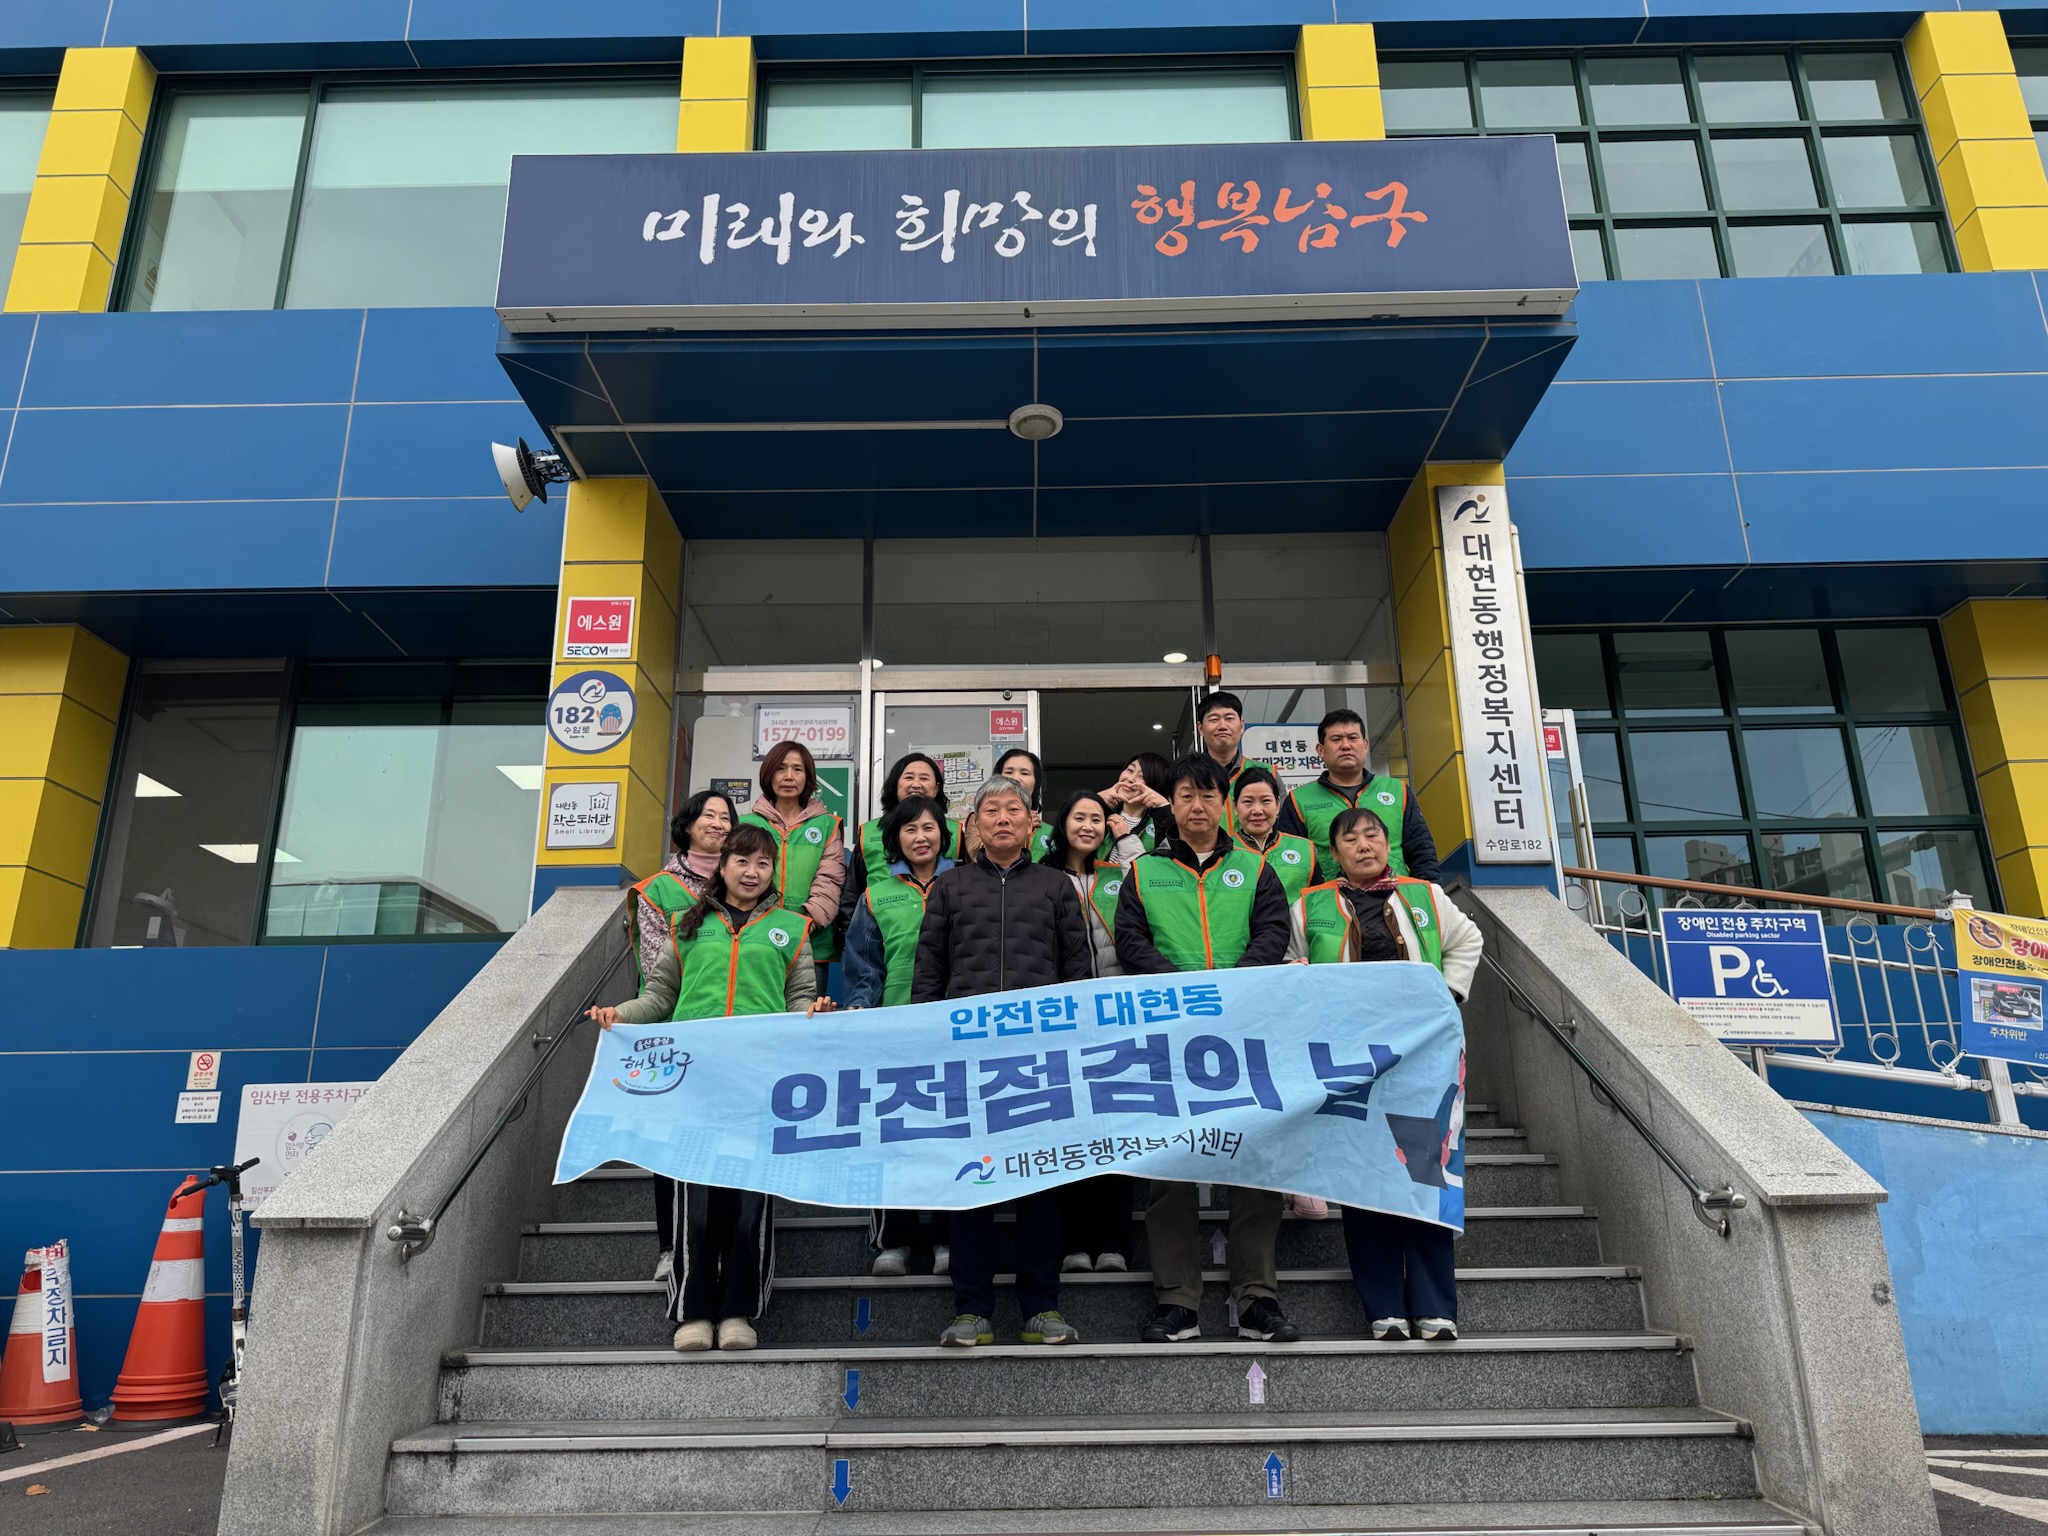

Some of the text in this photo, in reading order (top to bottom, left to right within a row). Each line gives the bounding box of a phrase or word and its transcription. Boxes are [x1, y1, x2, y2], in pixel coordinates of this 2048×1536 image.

[643, 180, 1428, 265] 미래와 희망의 행복남구
[577, 614, 622, 631] 에스원
[567, 646, 608, 655] SECOM
[1462, 534, 1526, 830] 대현동행정복지센터
[555, 706, 595, 724] 182
[995, 717, 1018, 726] 에스원
[564, 726, 590, 734] 수암로
[763, 727, 846, 742] 1577-0199
[1265, 740, 1307, 753] 대현동
[1298, 756, 1328, 770] 지원
[553, 813, 612, 827] 작은도서관
[1485, 839, 1543, 851] 수암로182
[1677, 916, 1808, 932] 장애인 전용 주차구역
[1709, 945, 1751, 997] P
[950, 983, 1224, 1041] 안전한 대현동
[1990, 1026, 2028, 1042] 주차위반
[620, 1048, 695, 1083] 행복남구
[250, 1090, 290, 1105] 임산부
[771, 1033, 1402, 1155] 안전점검의 날
